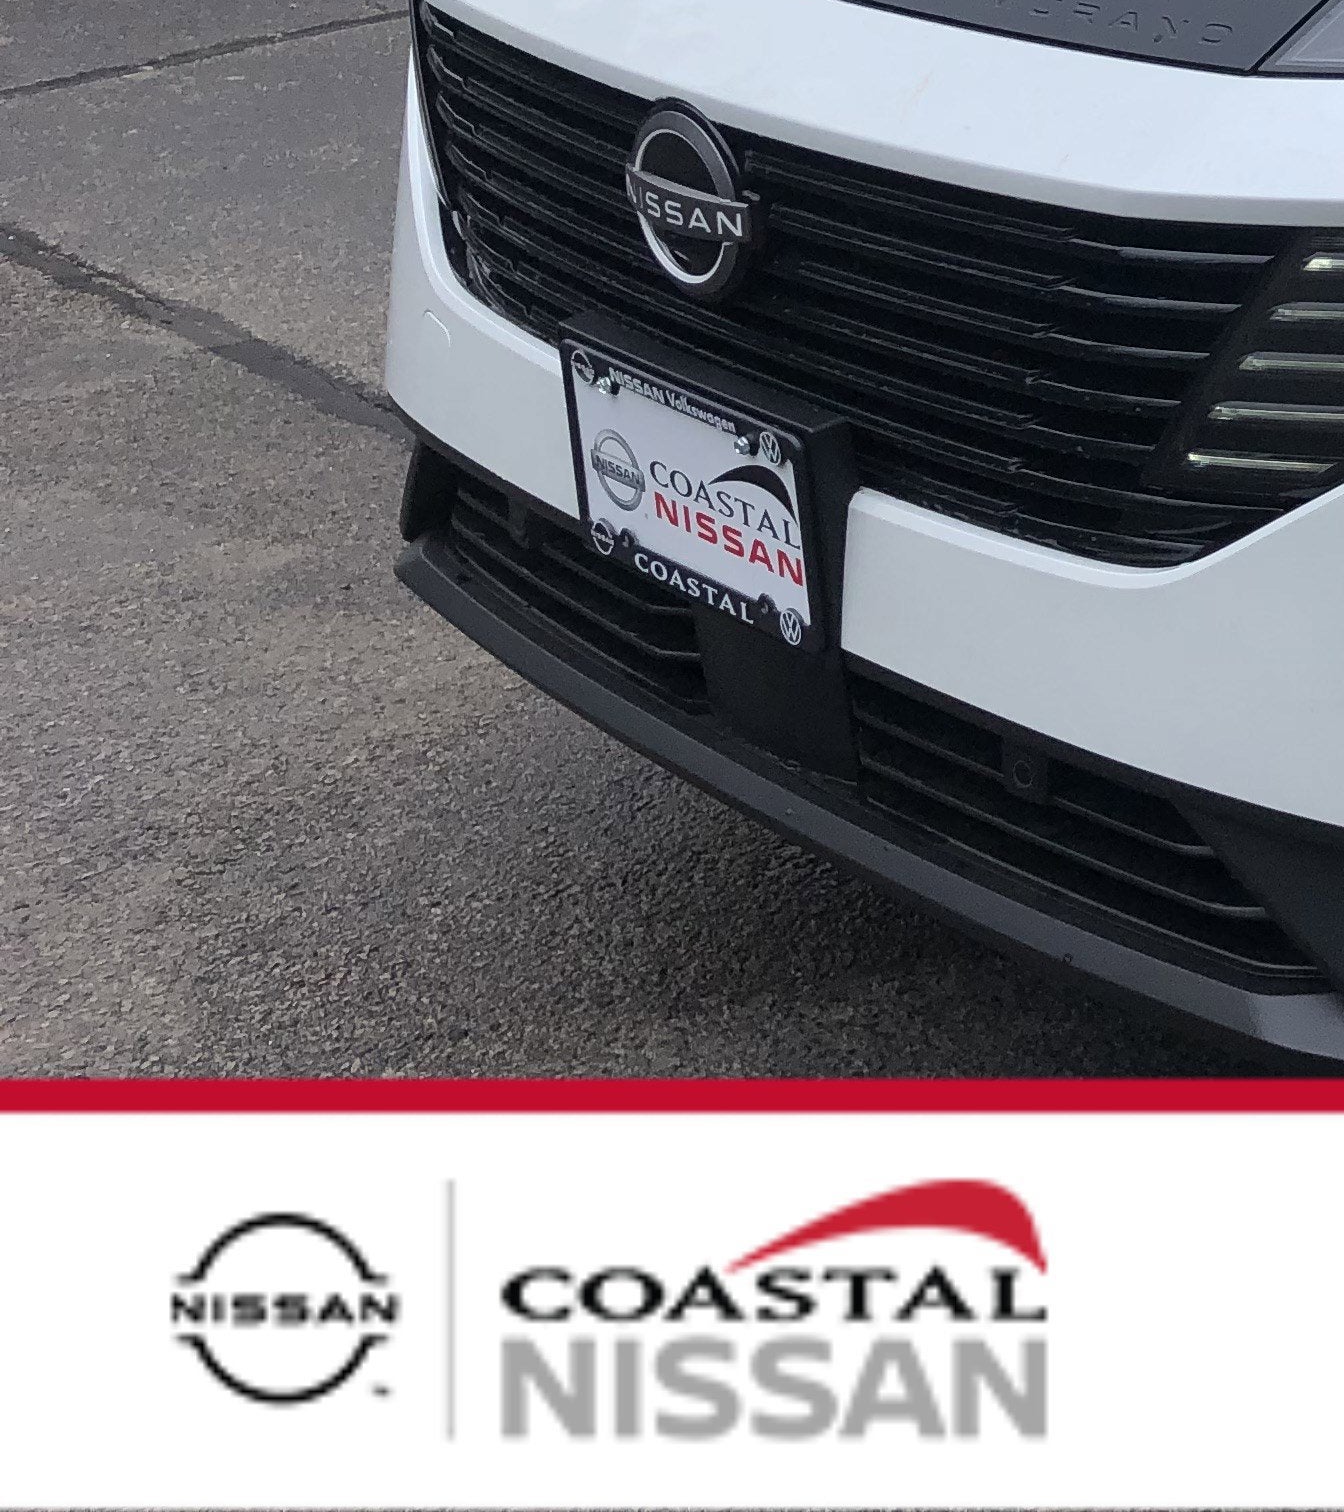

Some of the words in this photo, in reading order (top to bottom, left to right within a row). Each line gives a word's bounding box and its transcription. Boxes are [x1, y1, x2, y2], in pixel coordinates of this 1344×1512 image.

[626, 173, 743, 238] NISSAN
[608, 366, 665, 405] NISSAN
[665, 389, 736, 434] Volkswagen
[595, 453, 642, 485] NISSAN
[649, 460, 802, 551] COASTAL
[654, 491, 805, 587] NISSAN
[634, 552, 754, 625] COASTAL
